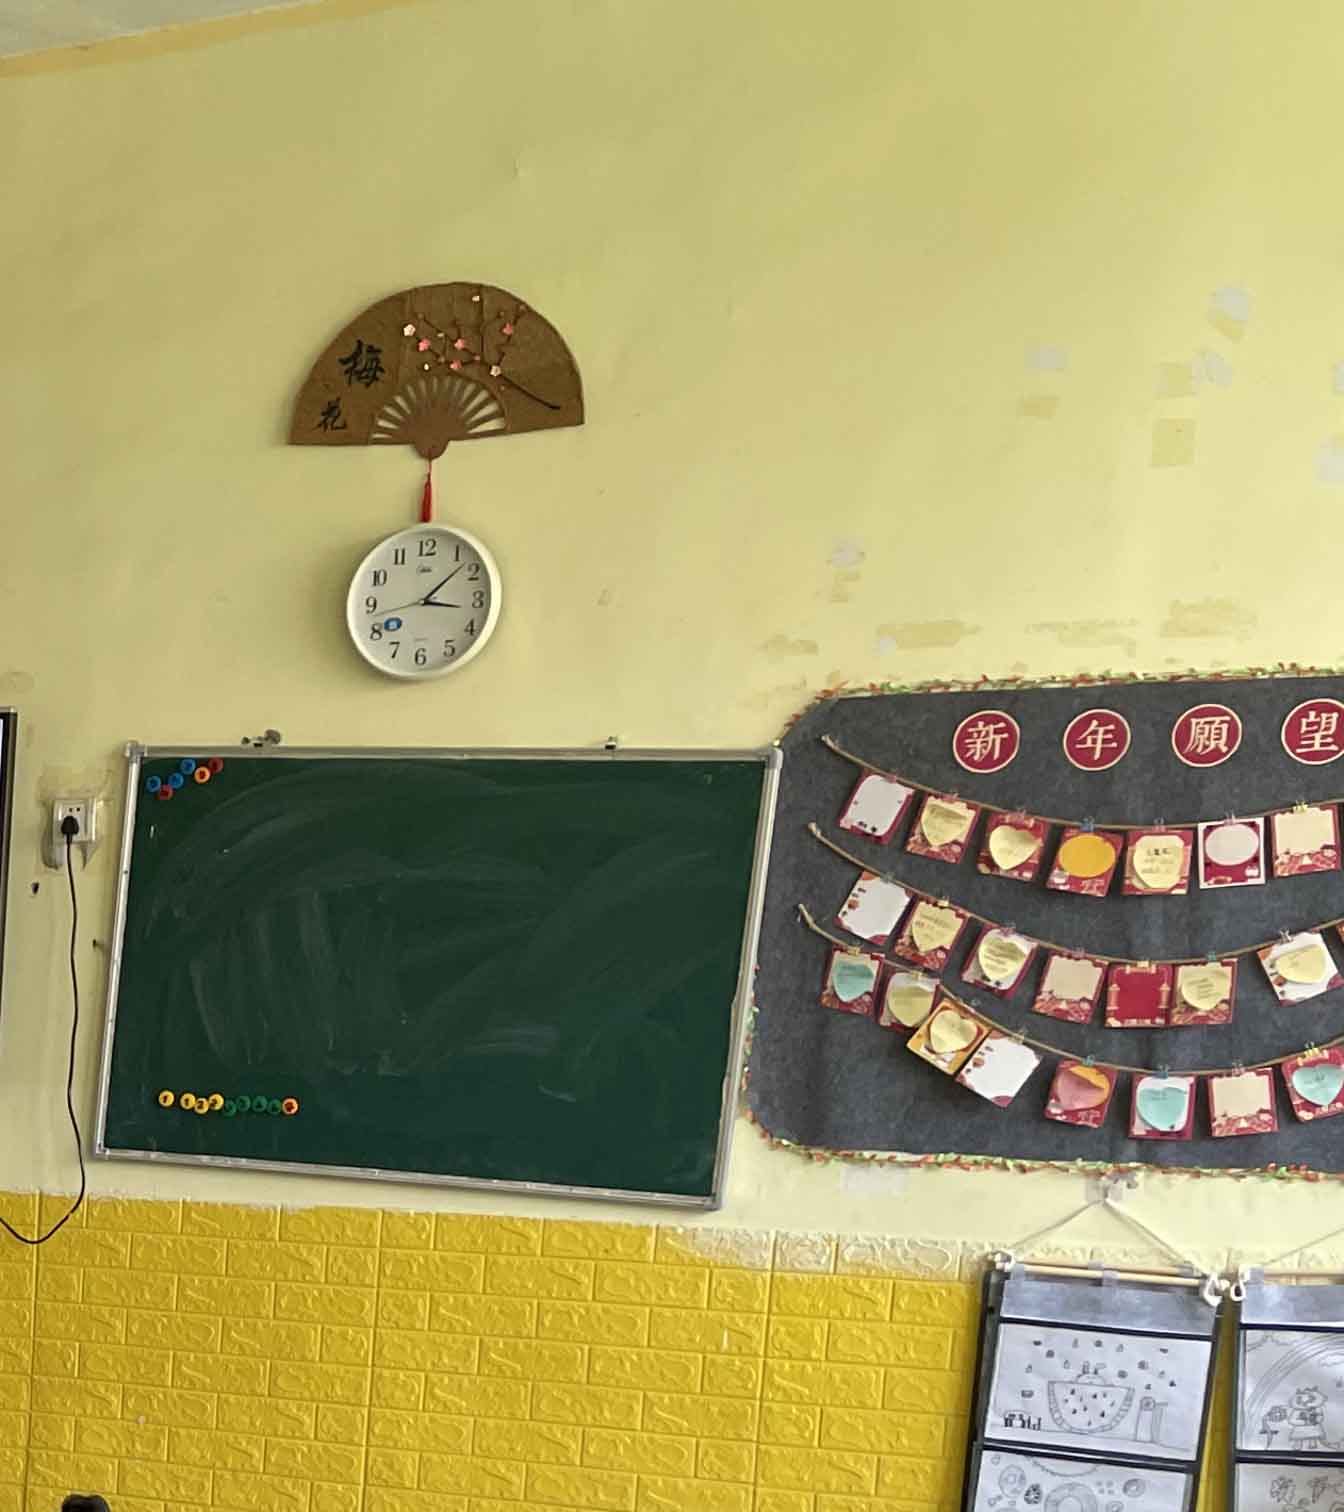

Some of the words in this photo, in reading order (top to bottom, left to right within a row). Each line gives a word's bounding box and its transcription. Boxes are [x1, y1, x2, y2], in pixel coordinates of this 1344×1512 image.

[394, 548, 405, 565] 11
[418, 538, 436, 557] 12
[454, 544, 460, 562] 1
[372, 569, 387, 587] 10
[467, 562, 480, 581] 2
[365, 596, 377, 614] 9
[472, 590, 484, 609] 3
[370, 622, 383, 641] 8
[464, 618, 475, 636] 4
[389, 641, 400, 659] 7
[414, 647, 427, 665] 6
[443, 639, 456, 657] 5
